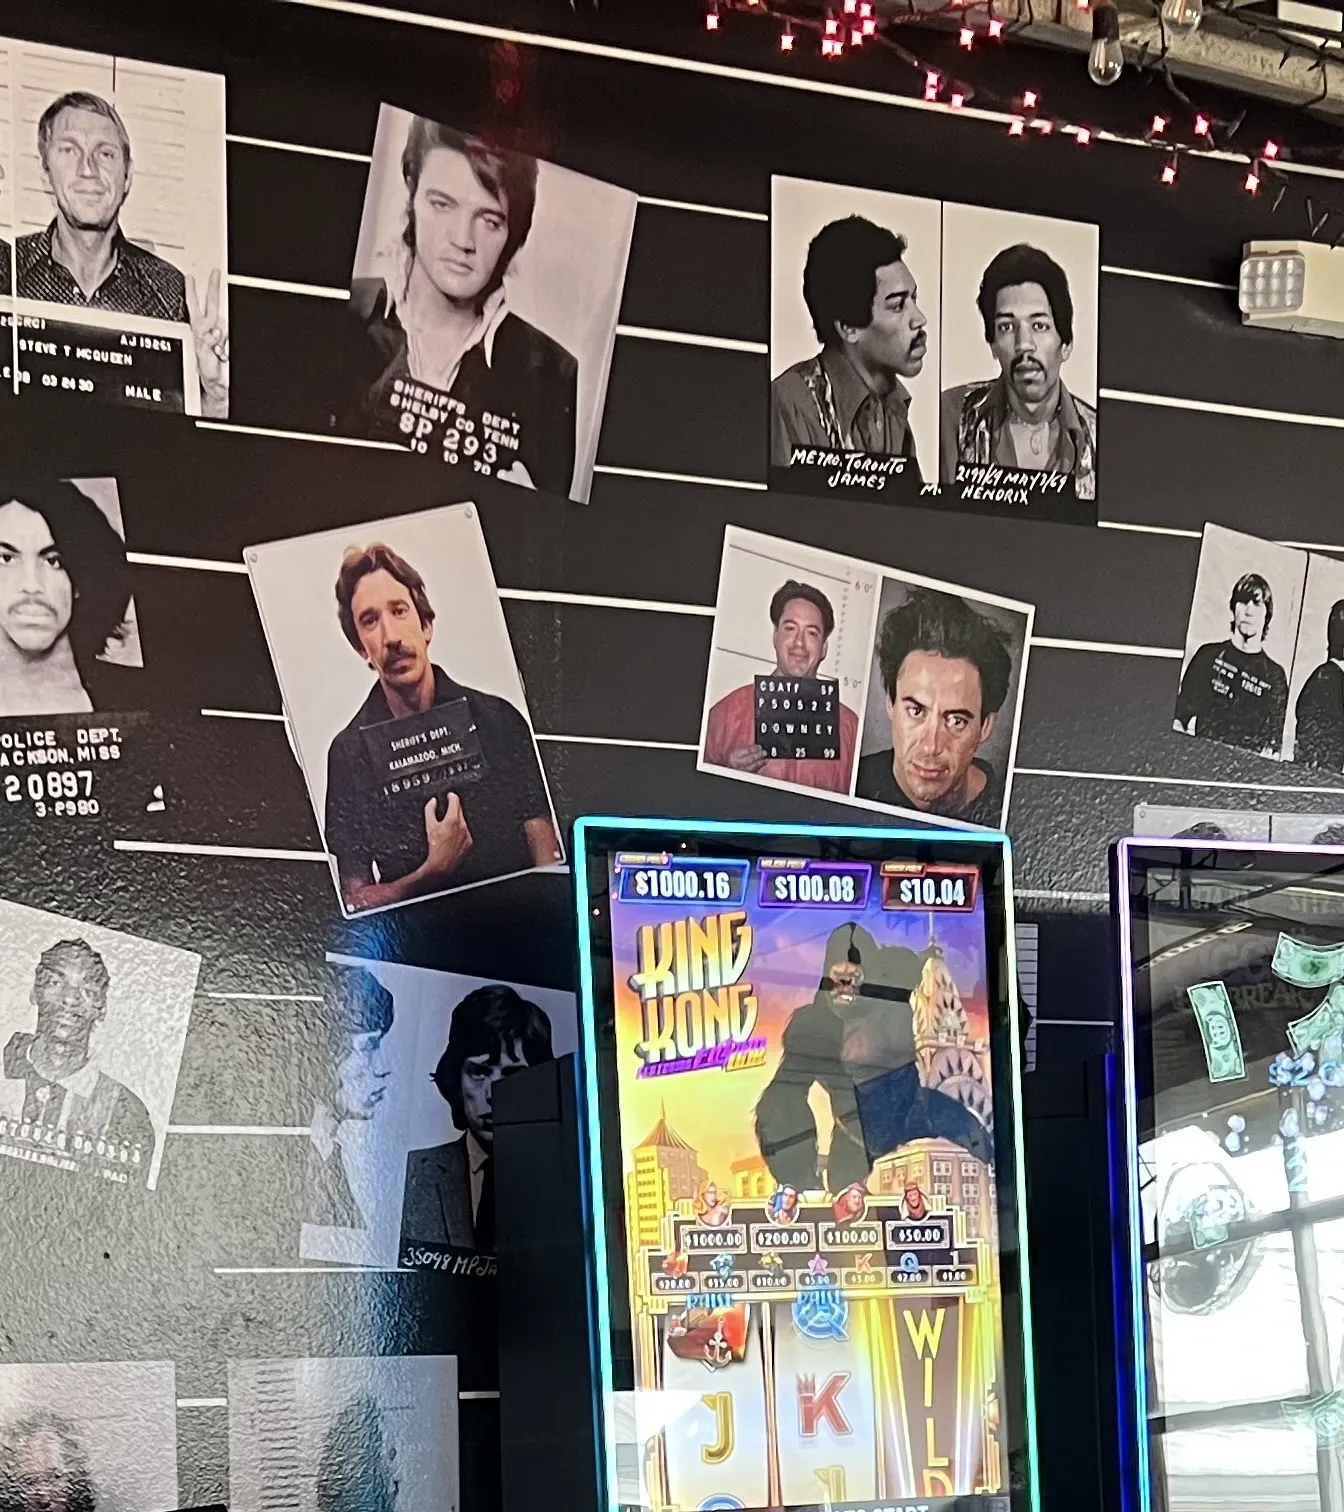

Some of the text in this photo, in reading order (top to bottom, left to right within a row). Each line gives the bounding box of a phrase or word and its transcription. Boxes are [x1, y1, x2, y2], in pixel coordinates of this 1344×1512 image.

[19, 339, 133, 366] STEVE T MCQUEEN
[125, 384, 162, 402] MALE
[455, 416, 475, 433] CO
[484, 427, 519, 450] TENN
[482, 411, 521, 435] DEPT
[845, 452, 907, 475] TORONTO
[828, 470, 886, 490] JAMES
[961, 484, 1028, 505] HENDRIX
[77, 728, 123, 744] DEPT.
[760, 722, 833, 736] DOWNEY
[77, 745, 121, 761] MISS
[4, 770, 93, 802] 20897
[635, 869, 965, 906] $1000.16 $100.08 $10.04
[628, 911, 752, 998] KING
[635, 984, 758, 1063] KONG
[685, 1228, 940, 1247] $1000.00 $200.00 $100.00 $50.00
[700, 1371, 854, 1464] J K
